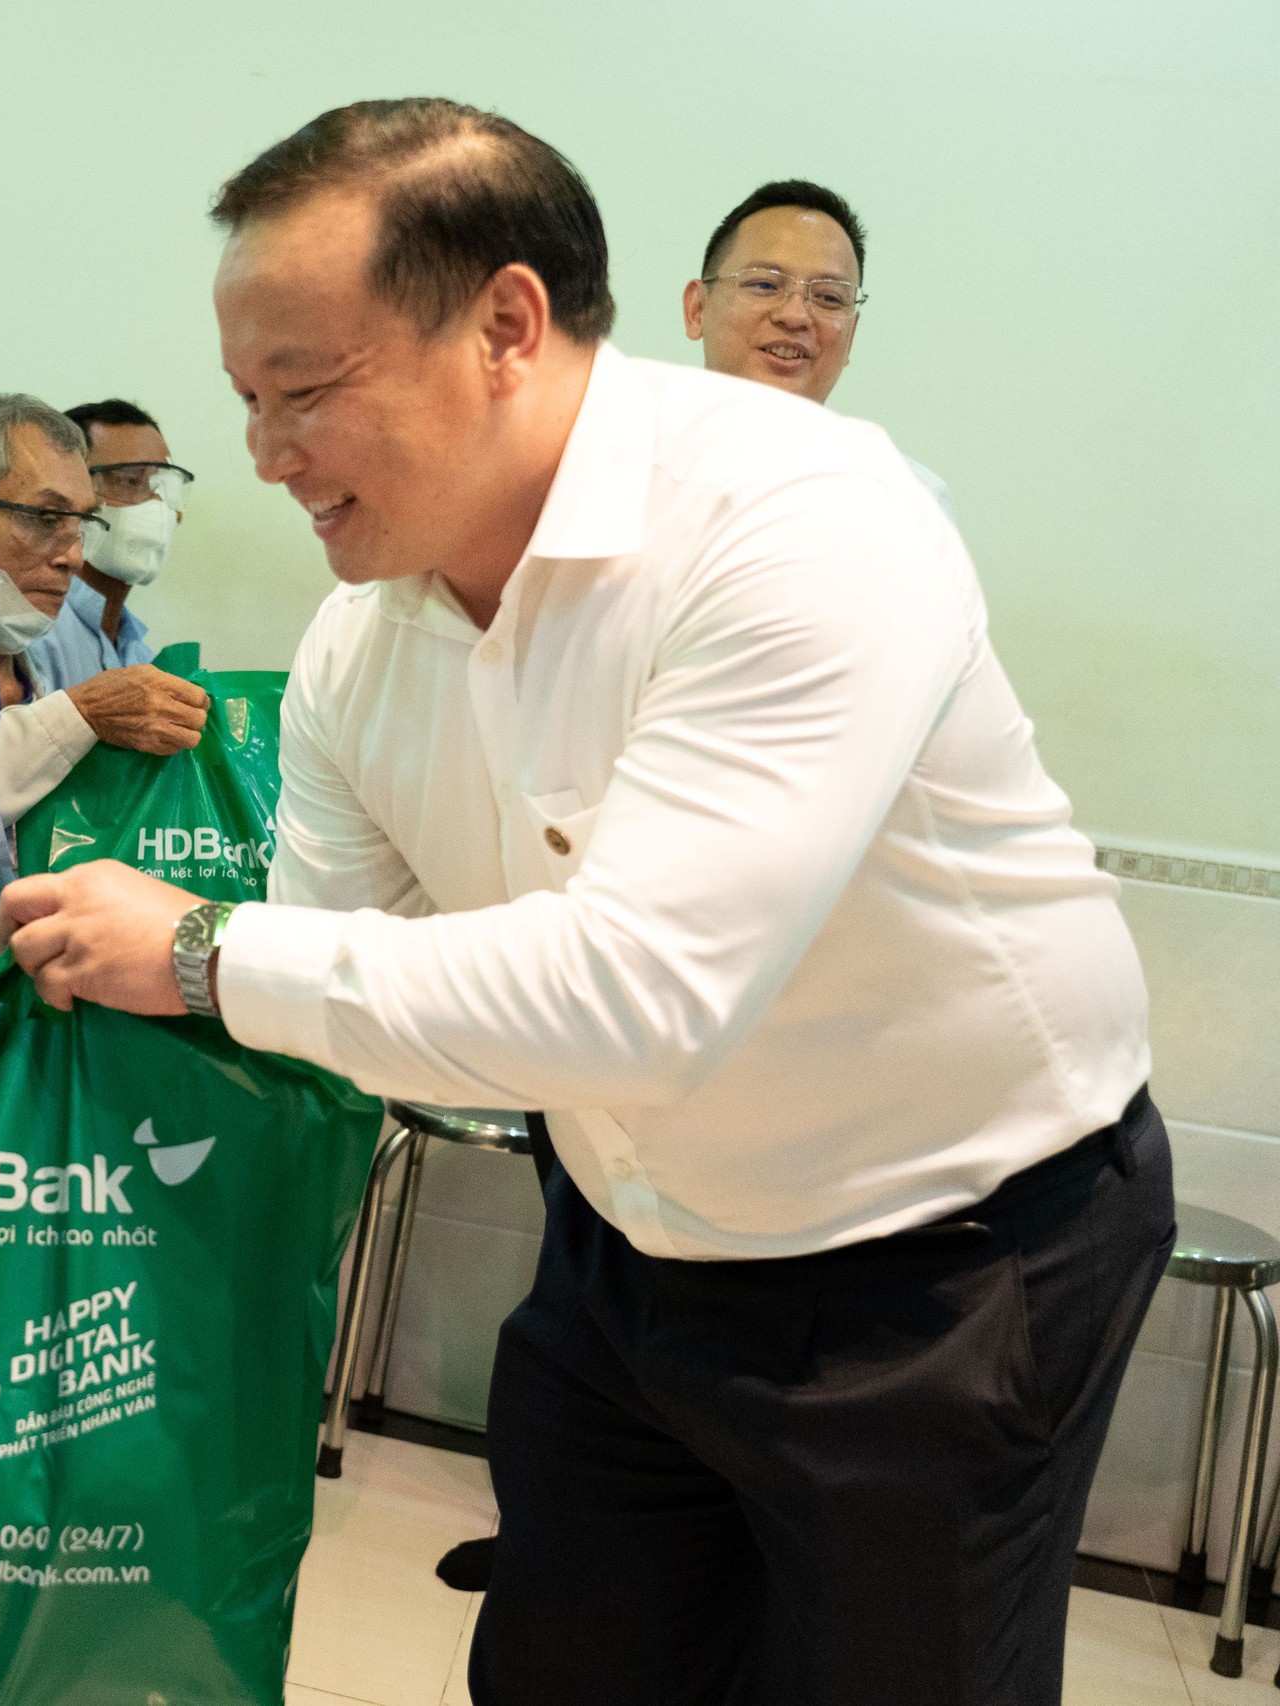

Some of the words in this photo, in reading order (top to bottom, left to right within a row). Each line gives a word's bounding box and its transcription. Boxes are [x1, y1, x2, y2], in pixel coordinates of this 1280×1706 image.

[137, 826, 272, 869] HDBank
[170, 864, 193, 879] kết
[199, 865, 216, 879] lợi
[27, 1223, 59, 1247] ích
[102, 1223, 157, 1247] nhất
[24, 1280, 138, 1346] HAPPY
[10, 1317, 141, 1383] DIGITAL
[58, 1338, 156, 1397] BANK
[76, 1387, 113, 1416] CÔNG
[80, 1405, 122, 1434] NHÂN
[58, 1521, 145, 1554] (24/7)
